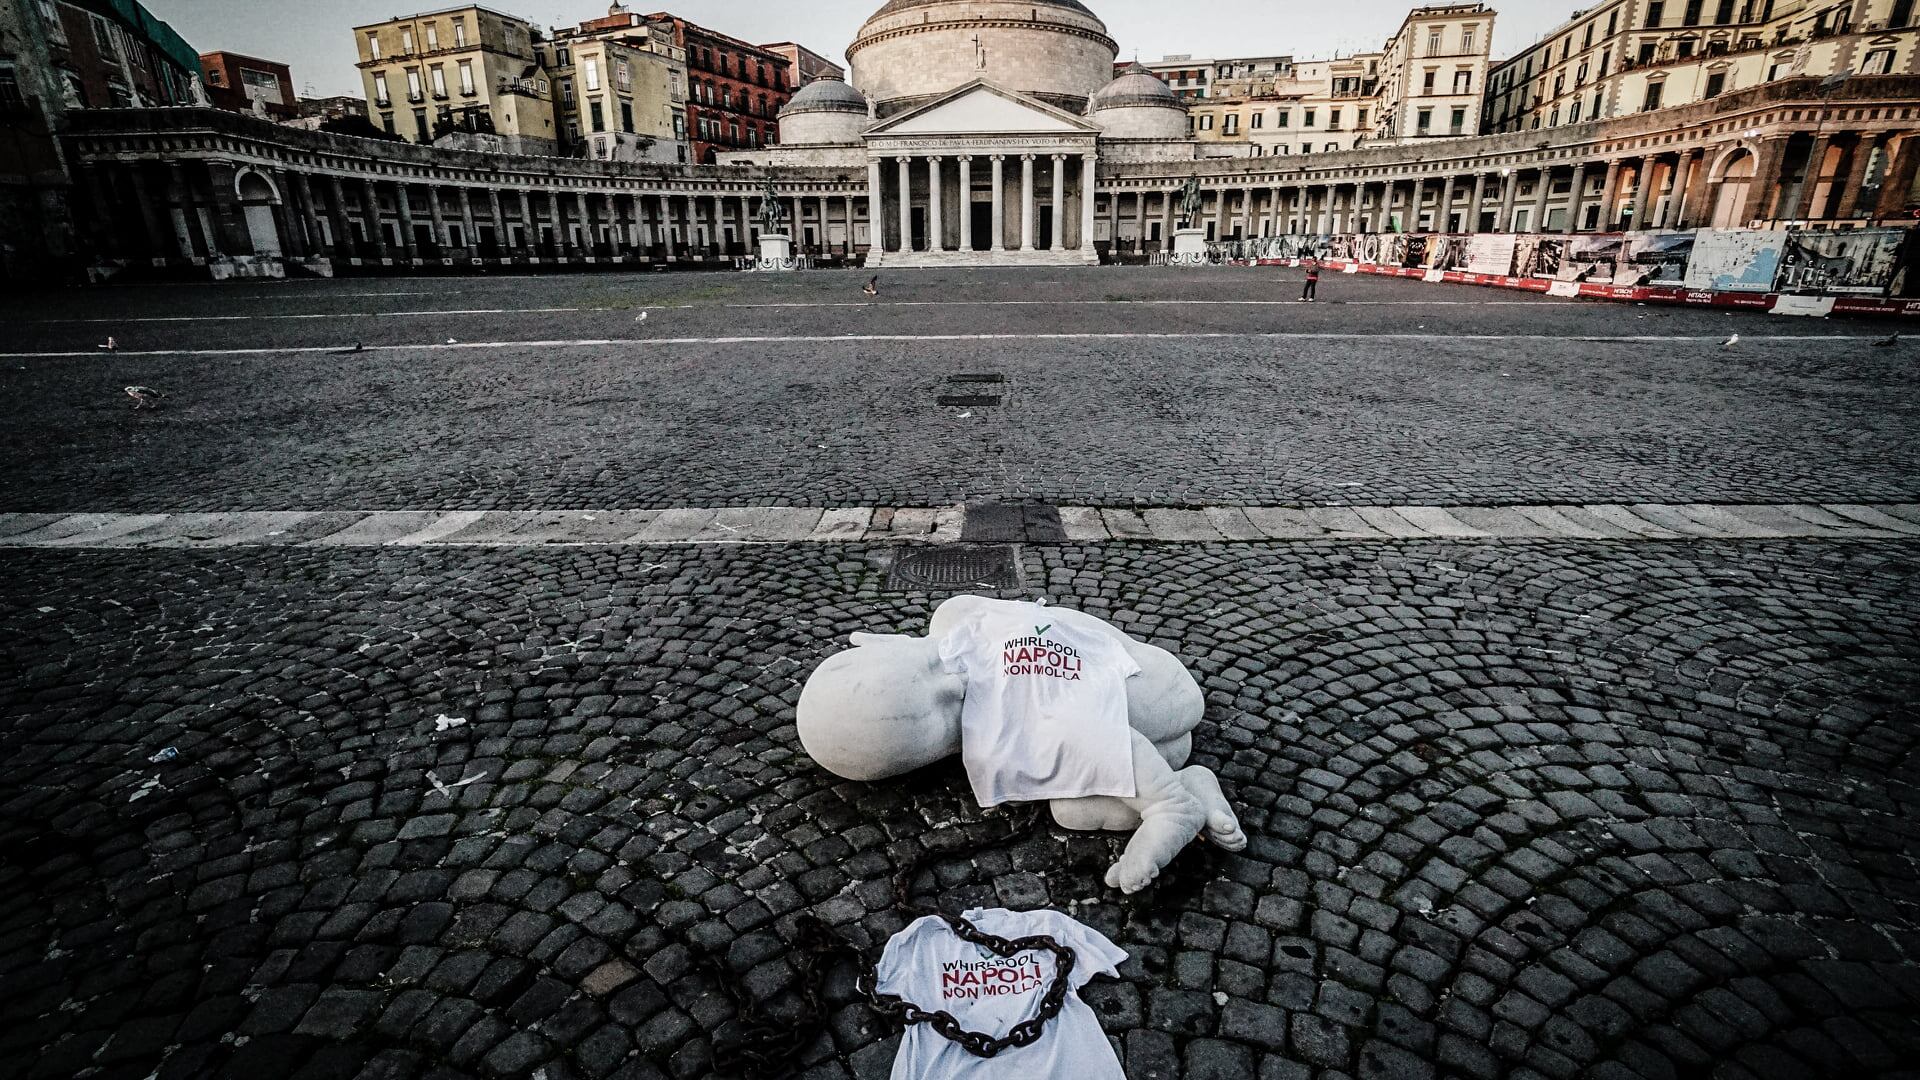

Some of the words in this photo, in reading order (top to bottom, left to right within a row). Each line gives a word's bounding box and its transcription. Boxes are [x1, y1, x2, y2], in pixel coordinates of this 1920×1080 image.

[1004, 636, 1081, 659] WHIRLPOOL
[1003, 647, 1081, 672] NAPOLI
[1033, 664, 1081, 681] MOLLA
[942, 953, 1040, 972] WHIRLPOOL
[942, 965, 1042, 988] NAPOLI
[943, 986, 979, 1000] NON
[983, 979, 1043, 996] MOLLA
